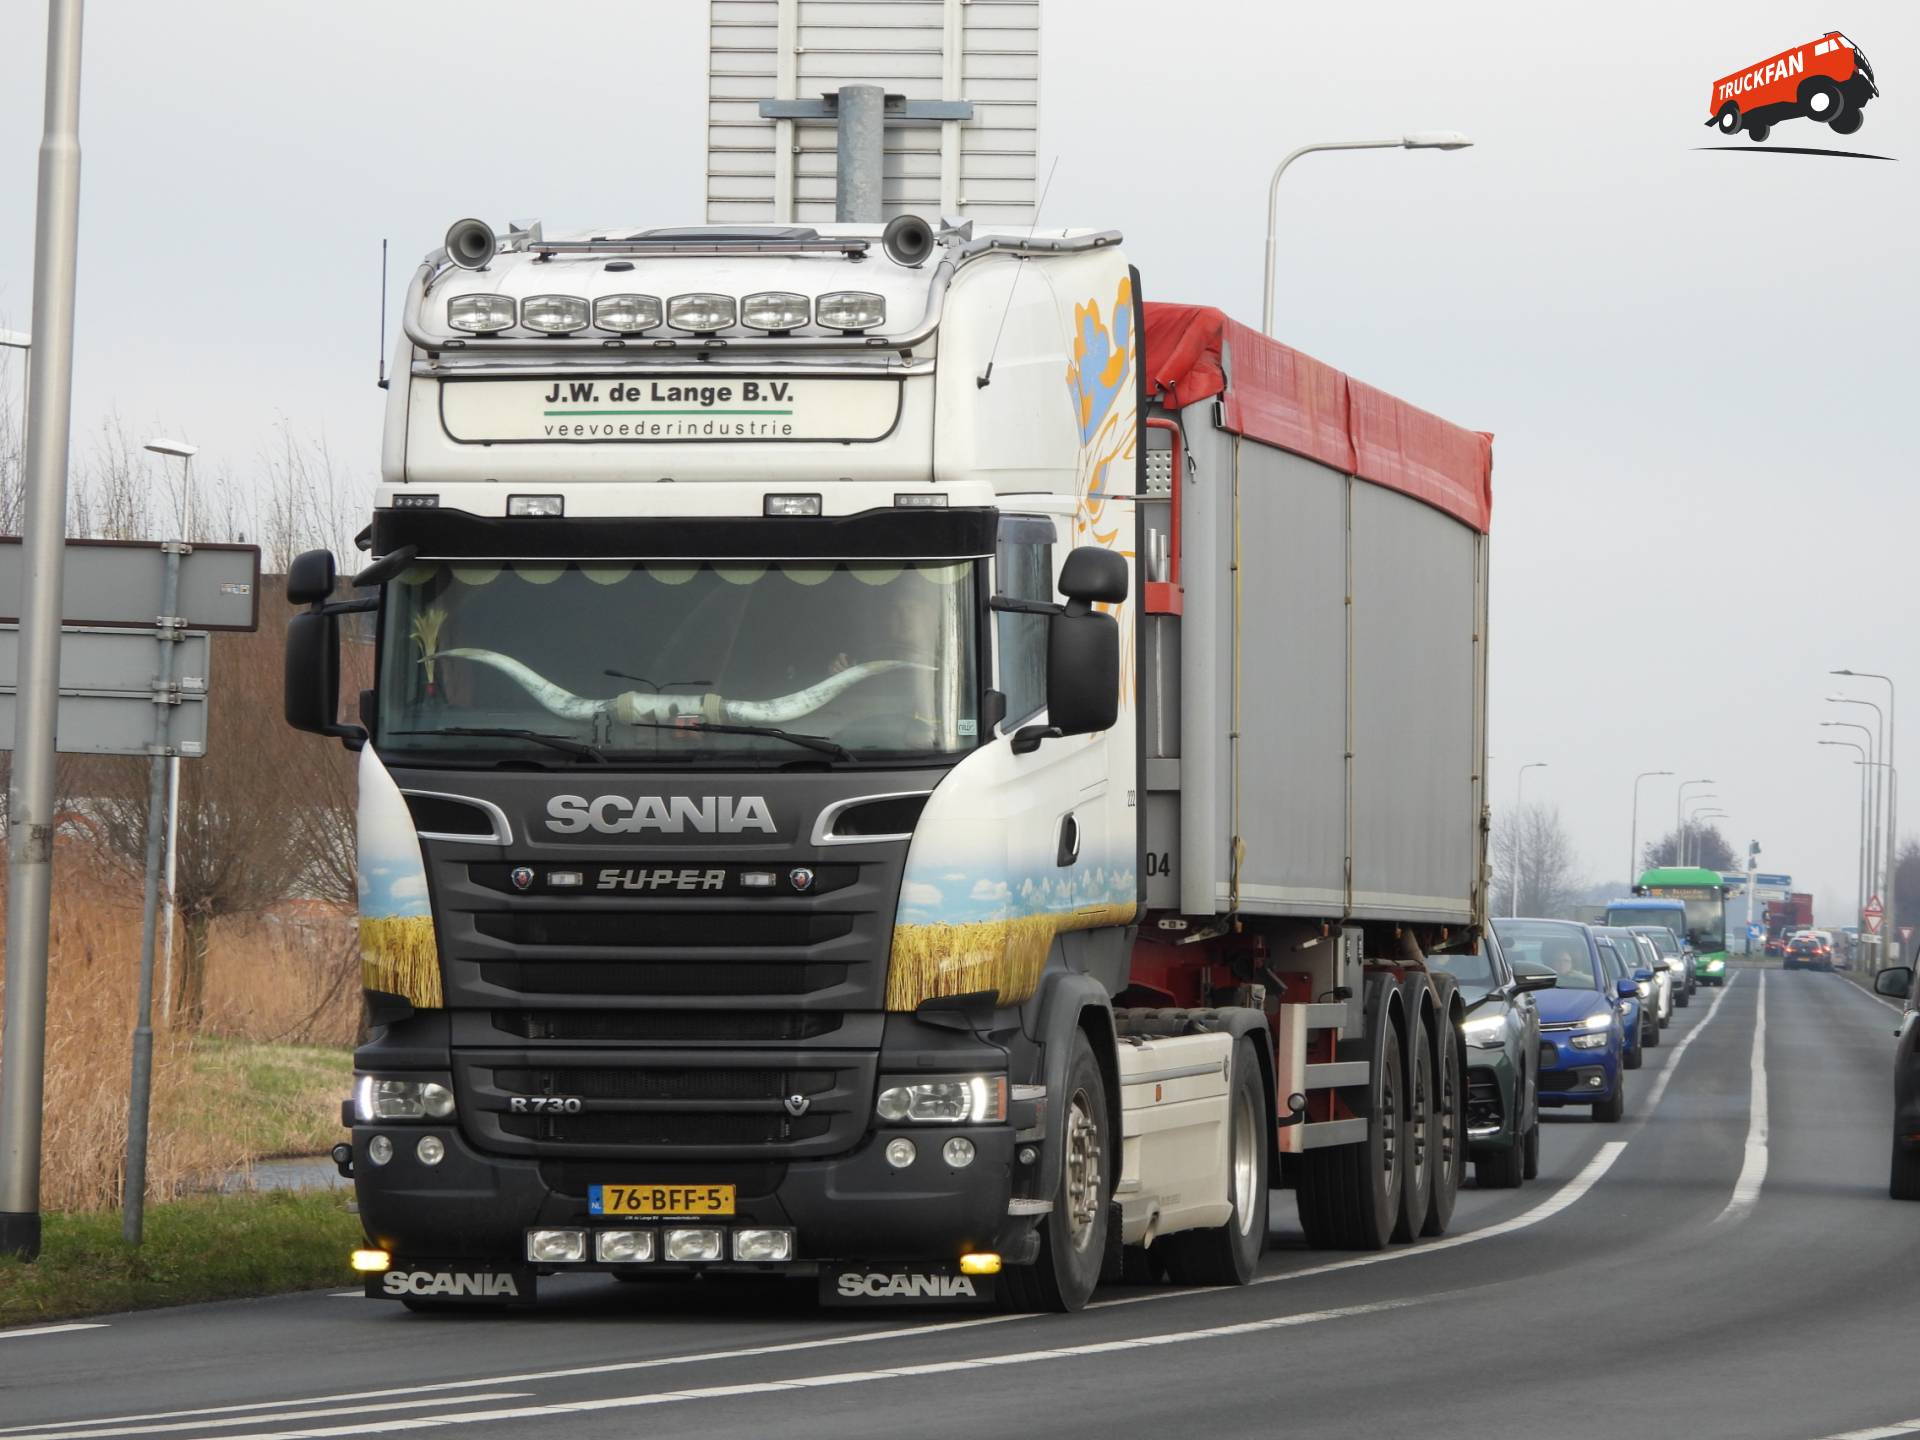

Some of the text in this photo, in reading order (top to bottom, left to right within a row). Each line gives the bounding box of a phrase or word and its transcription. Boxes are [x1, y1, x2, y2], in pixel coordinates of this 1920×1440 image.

[545, 381, 794, 407] J.W. de Lange B.V.
[544, 420, 793, 437] veevoederindustrie
[545, 794, 778, 834] SCANIA
[597, 869, 727, 890] SUPER
[510, 1097, 583, 1114] R 730
[610, 1188, 722, 1211] 76-BFF-5
[382, 1271, 519, 1297] SCANIA
[837, 1271, 977, 1297] SCANIA
